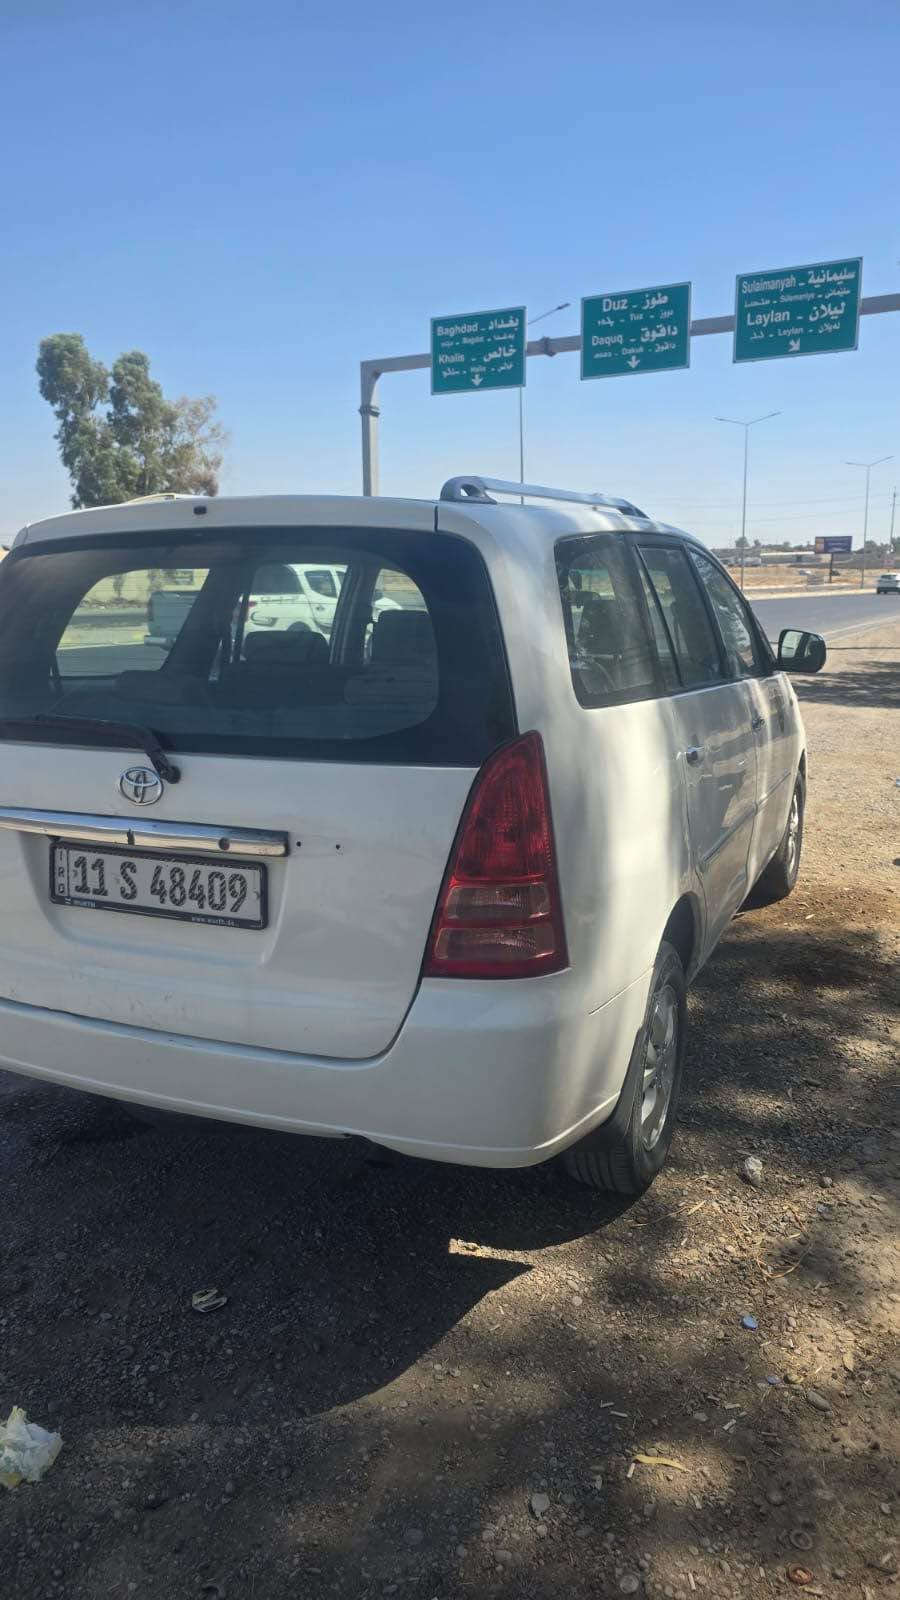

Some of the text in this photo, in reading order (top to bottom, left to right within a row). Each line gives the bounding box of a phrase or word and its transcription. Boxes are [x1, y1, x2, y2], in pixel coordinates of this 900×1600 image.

[742, 275, 796, 293] Sulaimanyah
[808, 268, 855, 288] سليمانية
[603, 299, 628, 312] Duz
[642, 293, 668, 309] طوز
[747, 311, 790, 327] Laylan
[809, 302, 846, 321] ليلان
[437, 323, 478, 337] Baghdad
[489, 315, 519, 331] بغداد
[592, 335, 623, 346] Daquq
[641, 324, 678, 342] داقوق
[439, 353, 464, 364] Khalis
[484, 344, 517, 362] خالص
[74, 855, 248, 913] 11 S 48409
